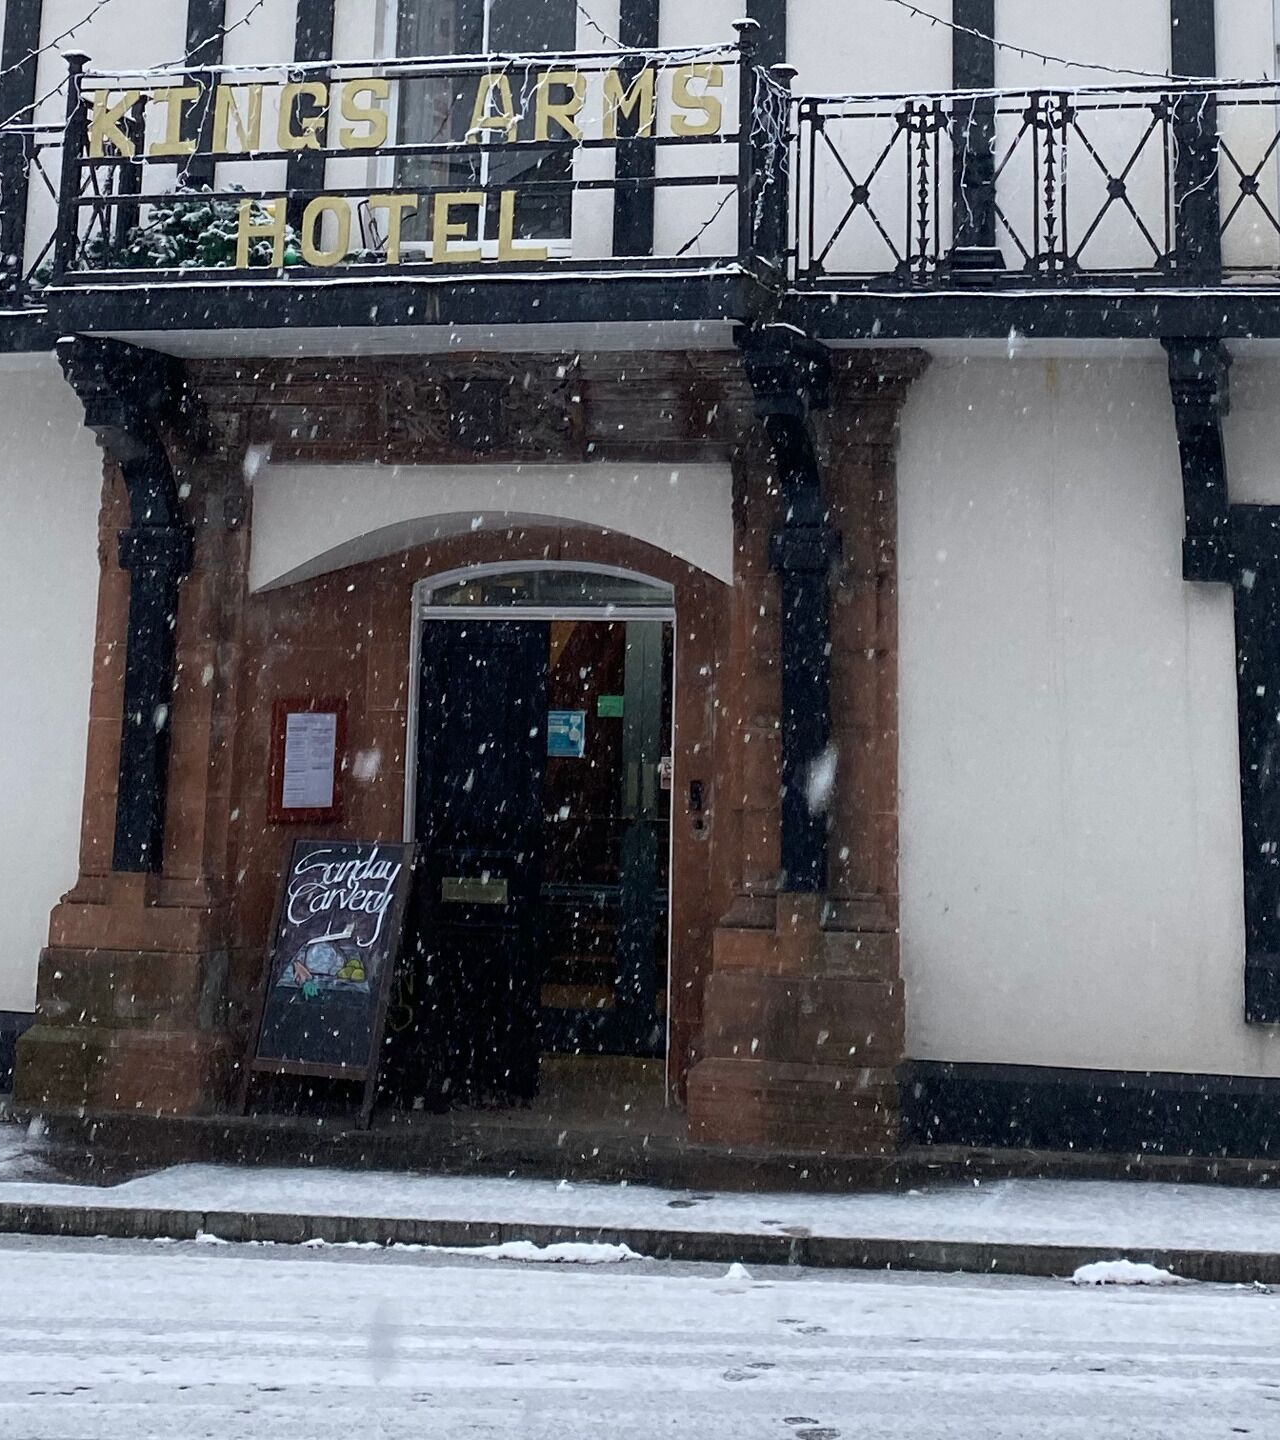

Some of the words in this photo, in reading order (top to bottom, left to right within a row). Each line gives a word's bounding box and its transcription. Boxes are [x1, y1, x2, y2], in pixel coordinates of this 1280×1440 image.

[87, 78, 391, 159] KINGS
[467, 64, 724, 145] ARMS
[235, 190, 549, 270] HOTEL
[294, 846, 402, 900] Sunday
[287, 877, 394, 947] Carvery
